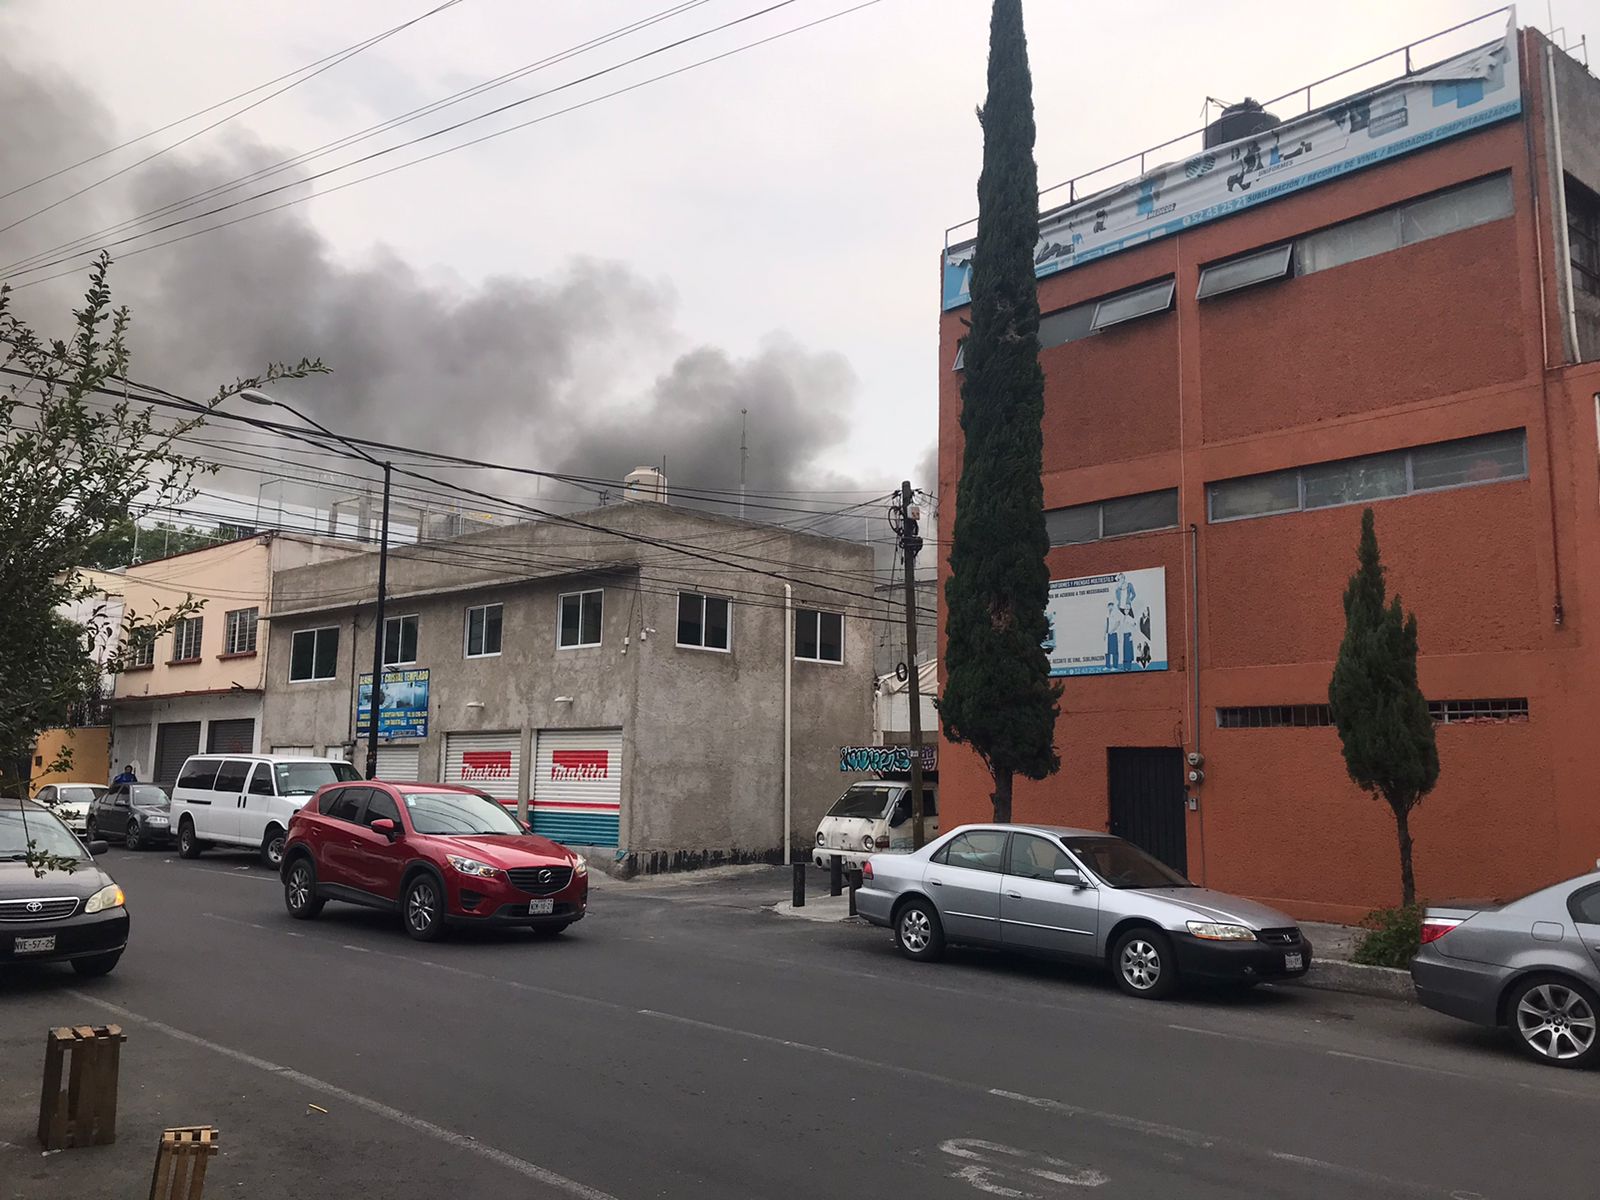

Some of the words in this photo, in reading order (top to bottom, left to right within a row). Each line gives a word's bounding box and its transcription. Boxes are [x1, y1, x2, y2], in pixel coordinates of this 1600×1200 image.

[1191, 210, 1204, 224] 52
[1206, 204, 1219, 217] 43
[1221, 200, 1233, 212] 25
[1236, 197, 1247, 209] 21
[1307, 164, 1343, 184] RECORTE
[1344, 160, 1356, 171] DE
[1357, 152, 1380, 167] VINIL
[1387, 130, 1434, 155] BORDADOS
[1435, 102, 1519, 137] COMPUTARIZADOS
